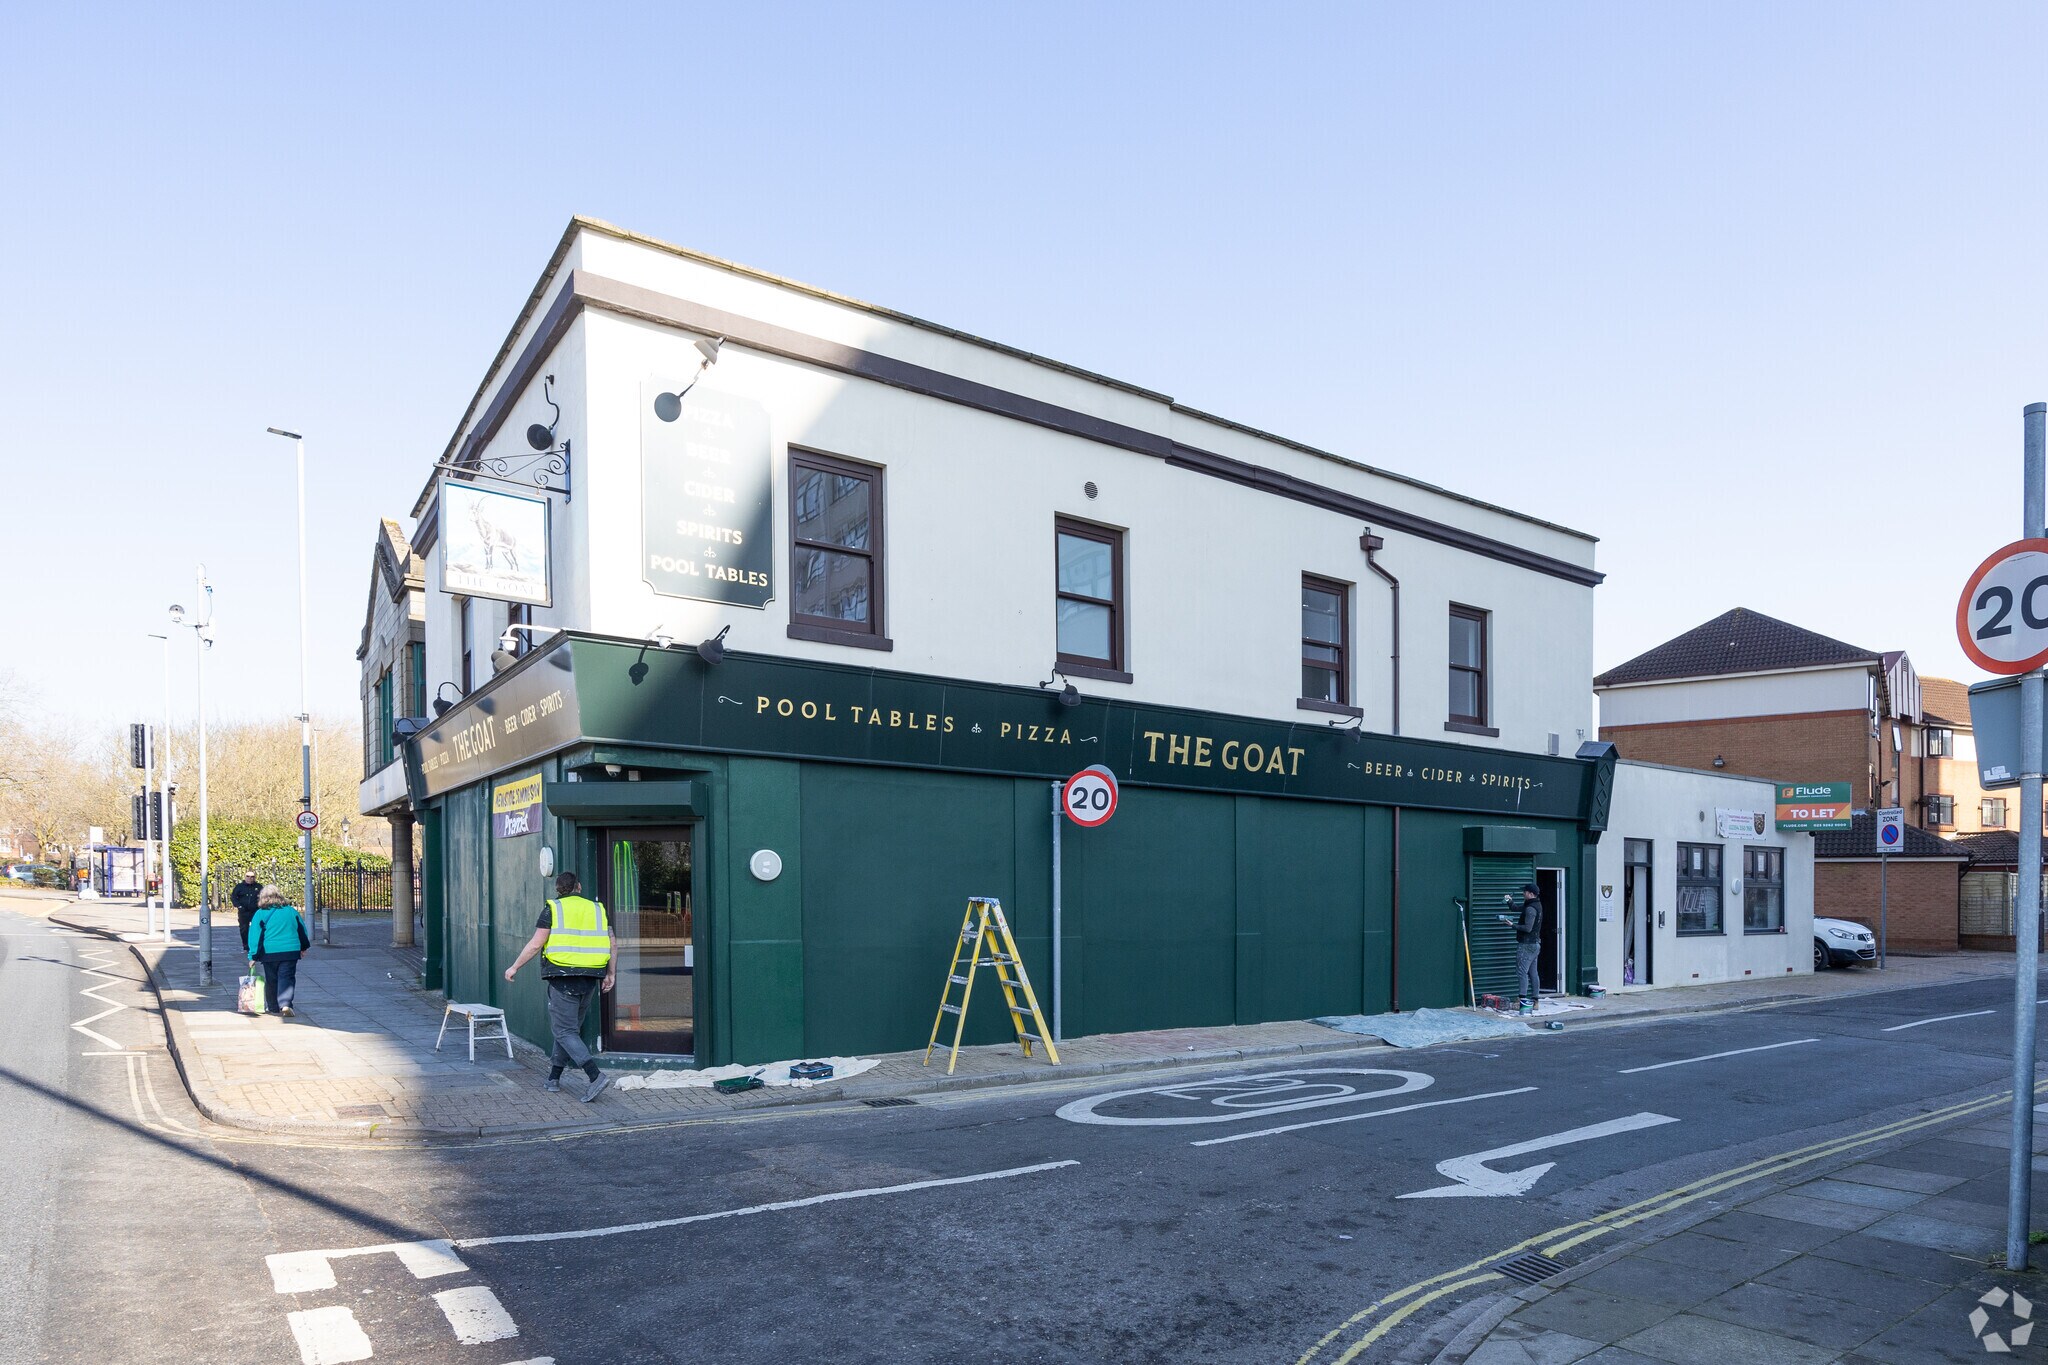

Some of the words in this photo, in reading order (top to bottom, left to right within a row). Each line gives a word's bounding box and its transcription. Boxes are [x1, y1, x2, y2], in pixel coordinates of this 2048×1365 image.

[686, 442, 732, 464] BEER
[683, 480, 736, 504] CIDER
[676, 520, 743, 545] SPIRITS
[650, 554, 700, 576] POOL
[705, 564, 768, 587] TABLES
[457, 575, 486, 588] THE
[496, 581, 537, 595] GOAT
[1975, 574, 2048, 641] 20
[452, 730, 472, 764] THE
[471, 715, 497, 756] GOAT
[504, 714, 518, 735] BEER
[520, 704, 538, 727] CIDER
[540, 690, 563, 718] SPIRITS
[757, 696, 837, 722] POOL
[850, 706, 955, 733] TABLES
[1000, 722, 1072, 744] PIZZA
[1143, 731, 1213, 768] THE
[1221, 741, 1305, 776] GOAT
[1365, 762, 1402, 777] BEER
[1421, 767, 1462, 783] CIDER
[1481, 773, 1532, 790] SPIRITS
[1071, 786, 1111, 812] 20
[1796, 786, 1832, 795] Flude
[1790, 809, 1809, 819] TO
[1811, 808, 1836, 818] LET
